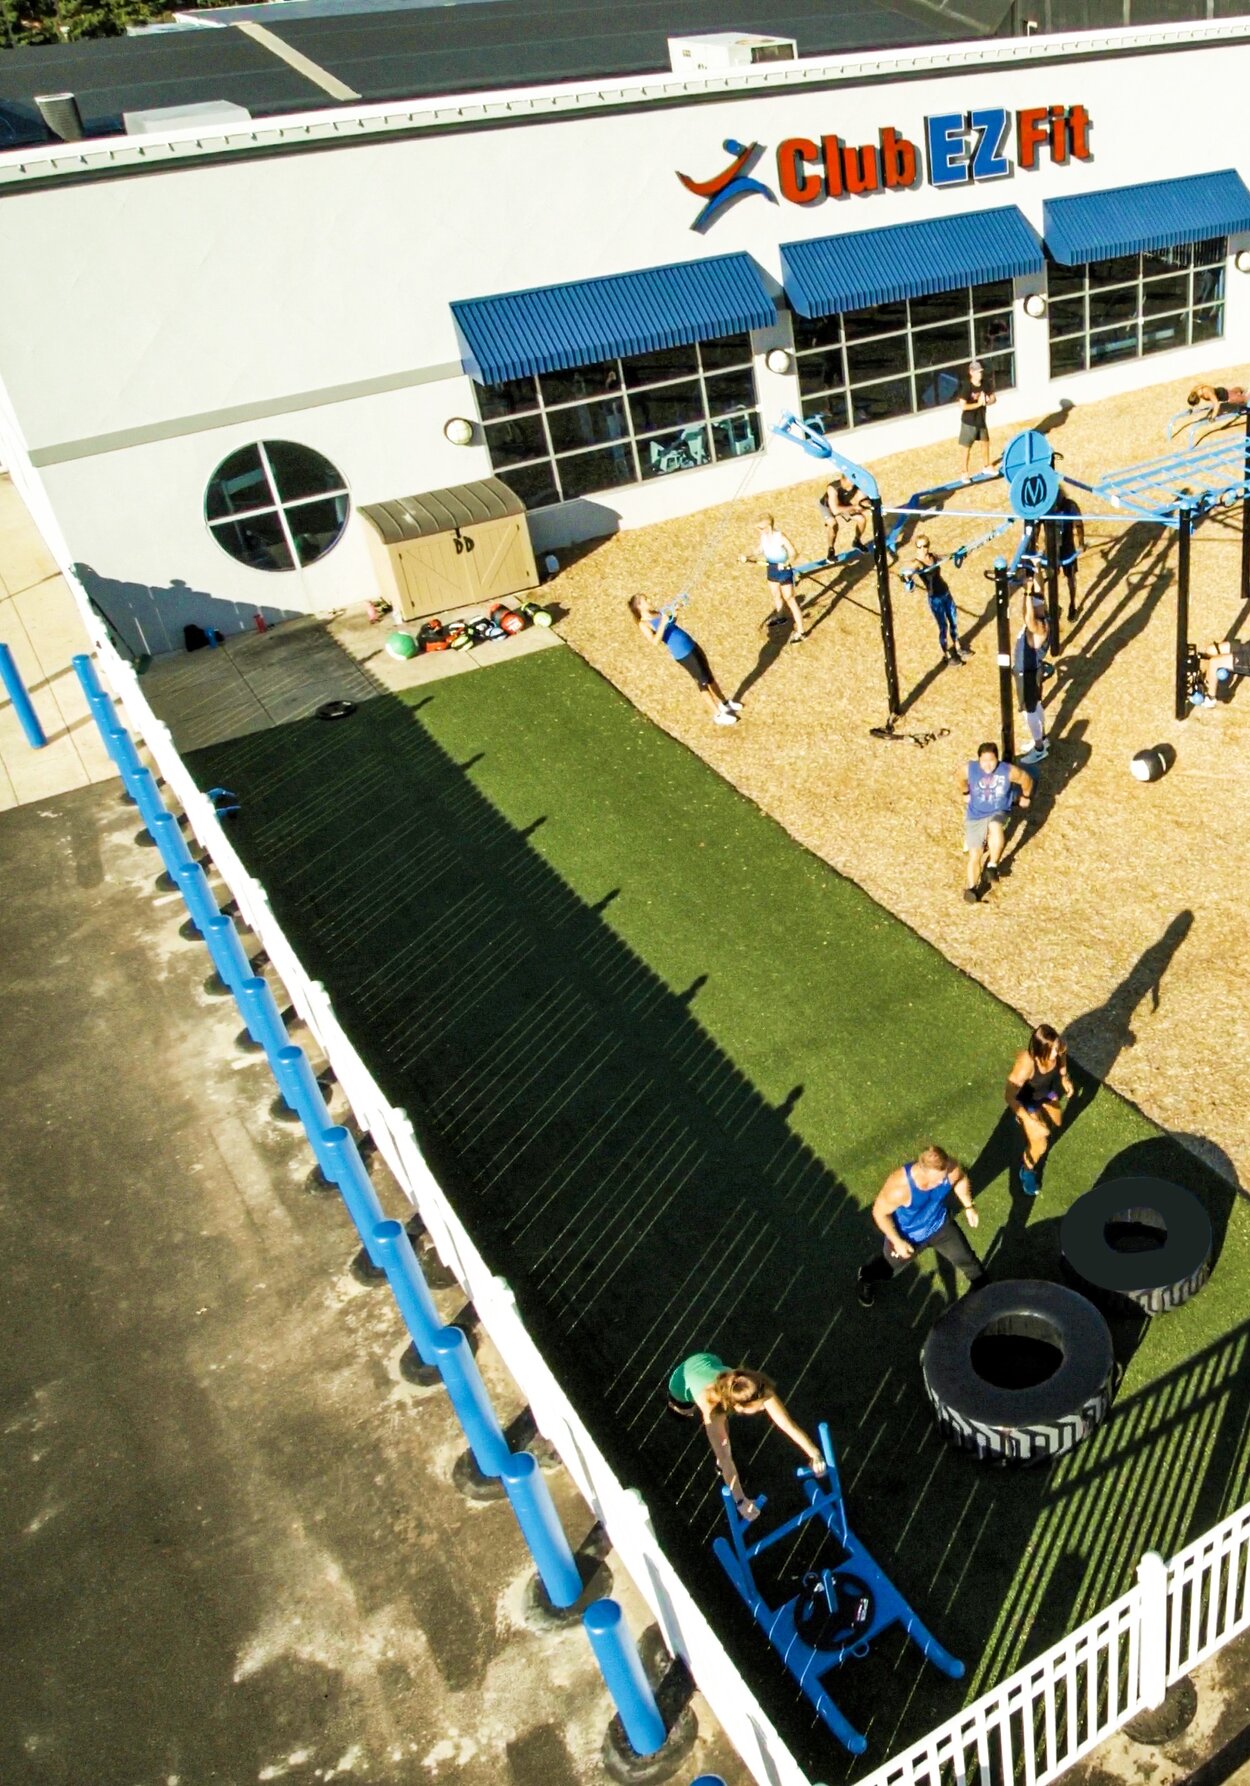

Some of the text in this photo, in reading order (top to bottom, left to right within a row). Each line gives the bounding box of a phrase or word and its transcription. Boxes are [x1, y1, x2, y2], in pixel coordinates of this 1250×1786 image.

[777, 104, 1092, 205] Club EZ Fit
